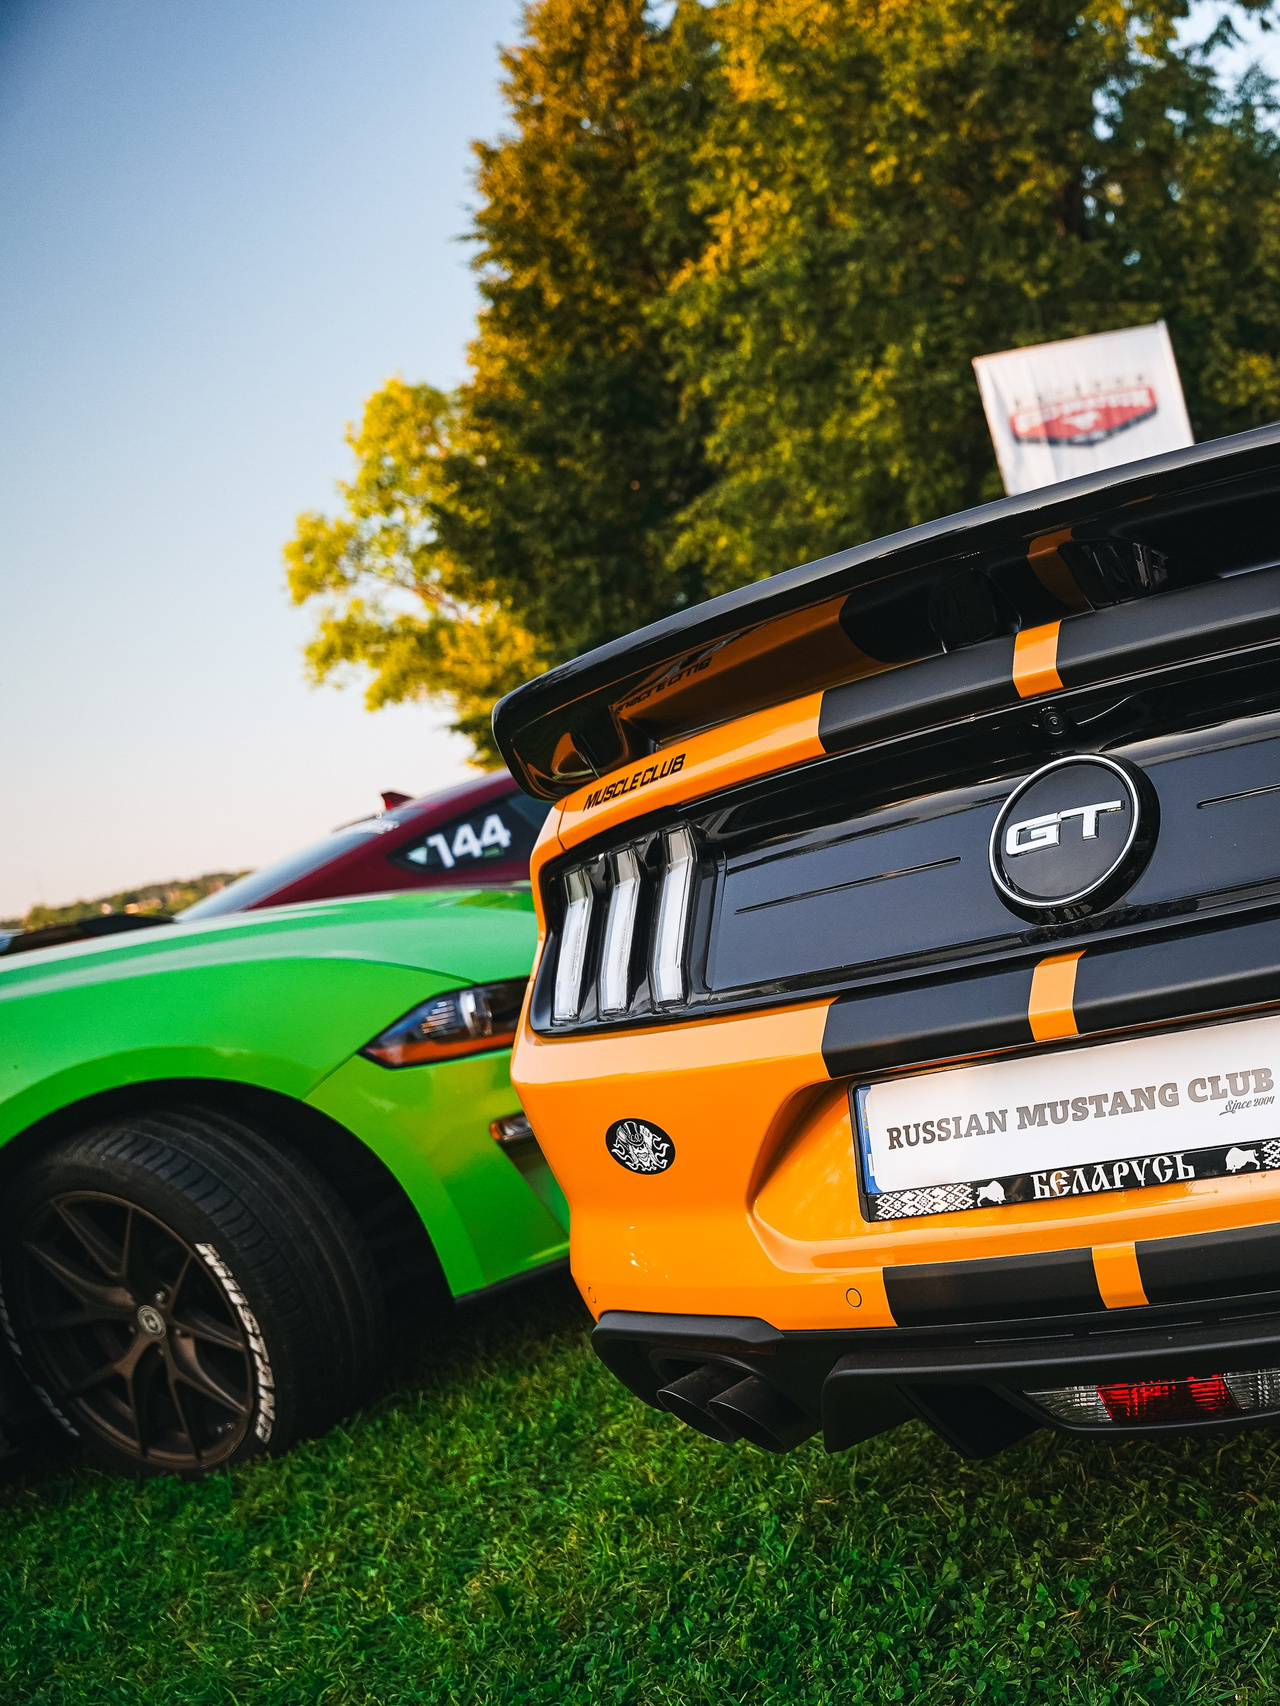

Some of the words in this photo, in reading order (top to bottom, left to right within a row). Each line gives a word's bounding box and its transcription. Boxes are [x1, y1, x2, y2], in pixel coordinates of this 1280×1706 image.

[583, 771, 643, 812] MUSCLE
[640, 753, 686, 787] CLUB
[426, 813, 512, 869] 144
[1005, 800, 1125, 857] GT
[886, 1109, 1008, 1150] RUSSIAN
[1016, 1083, 1179, 1130] MUSTANG
[1187, 1067, 1274, 1103] CLUB
[1219, 1099, 1252, 1116] Since
[1253, 1095, 1275, 1107] 2004
[1030, 1153, 1196, 1200] БЕЛАРУСЬ
